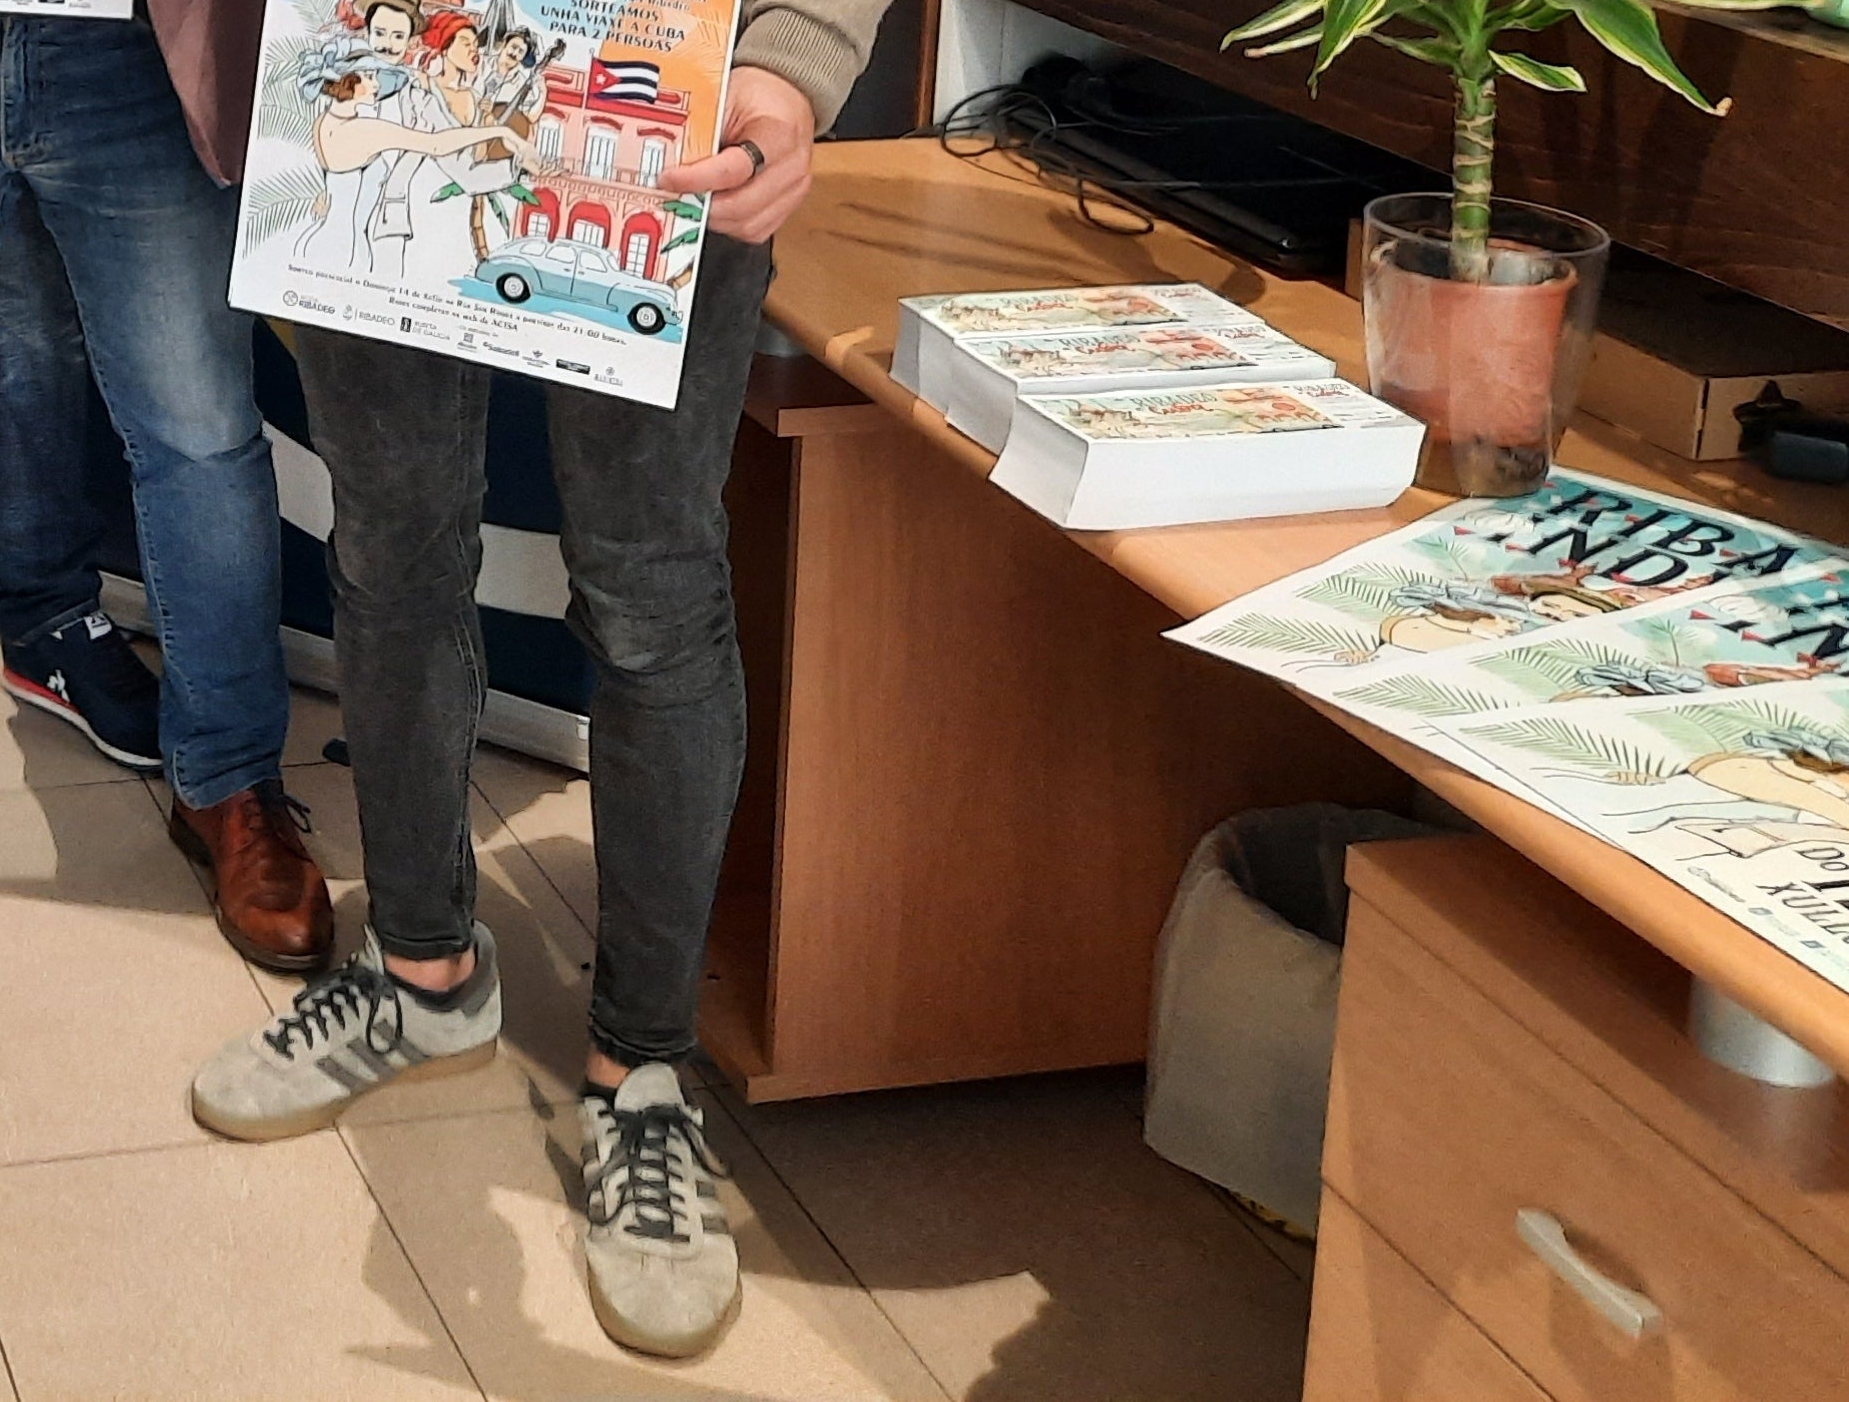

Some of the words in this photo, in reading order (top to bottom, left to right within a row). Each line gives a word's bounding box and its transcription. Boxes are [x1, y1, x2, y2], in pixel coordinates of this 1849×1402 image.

[541, 5, 581, 21] UNHA
[585, 13, 624, 29] VIAXE
[630, 22, 639, 32] A
[644, 24, 685, 40] CUBA
[550, 20, 587, 38] PARA
[591, 28, 601, 40] 2
[605, 30, 673, 53] PERSOAS
[1532, 488, 1799, 582] RIBA
